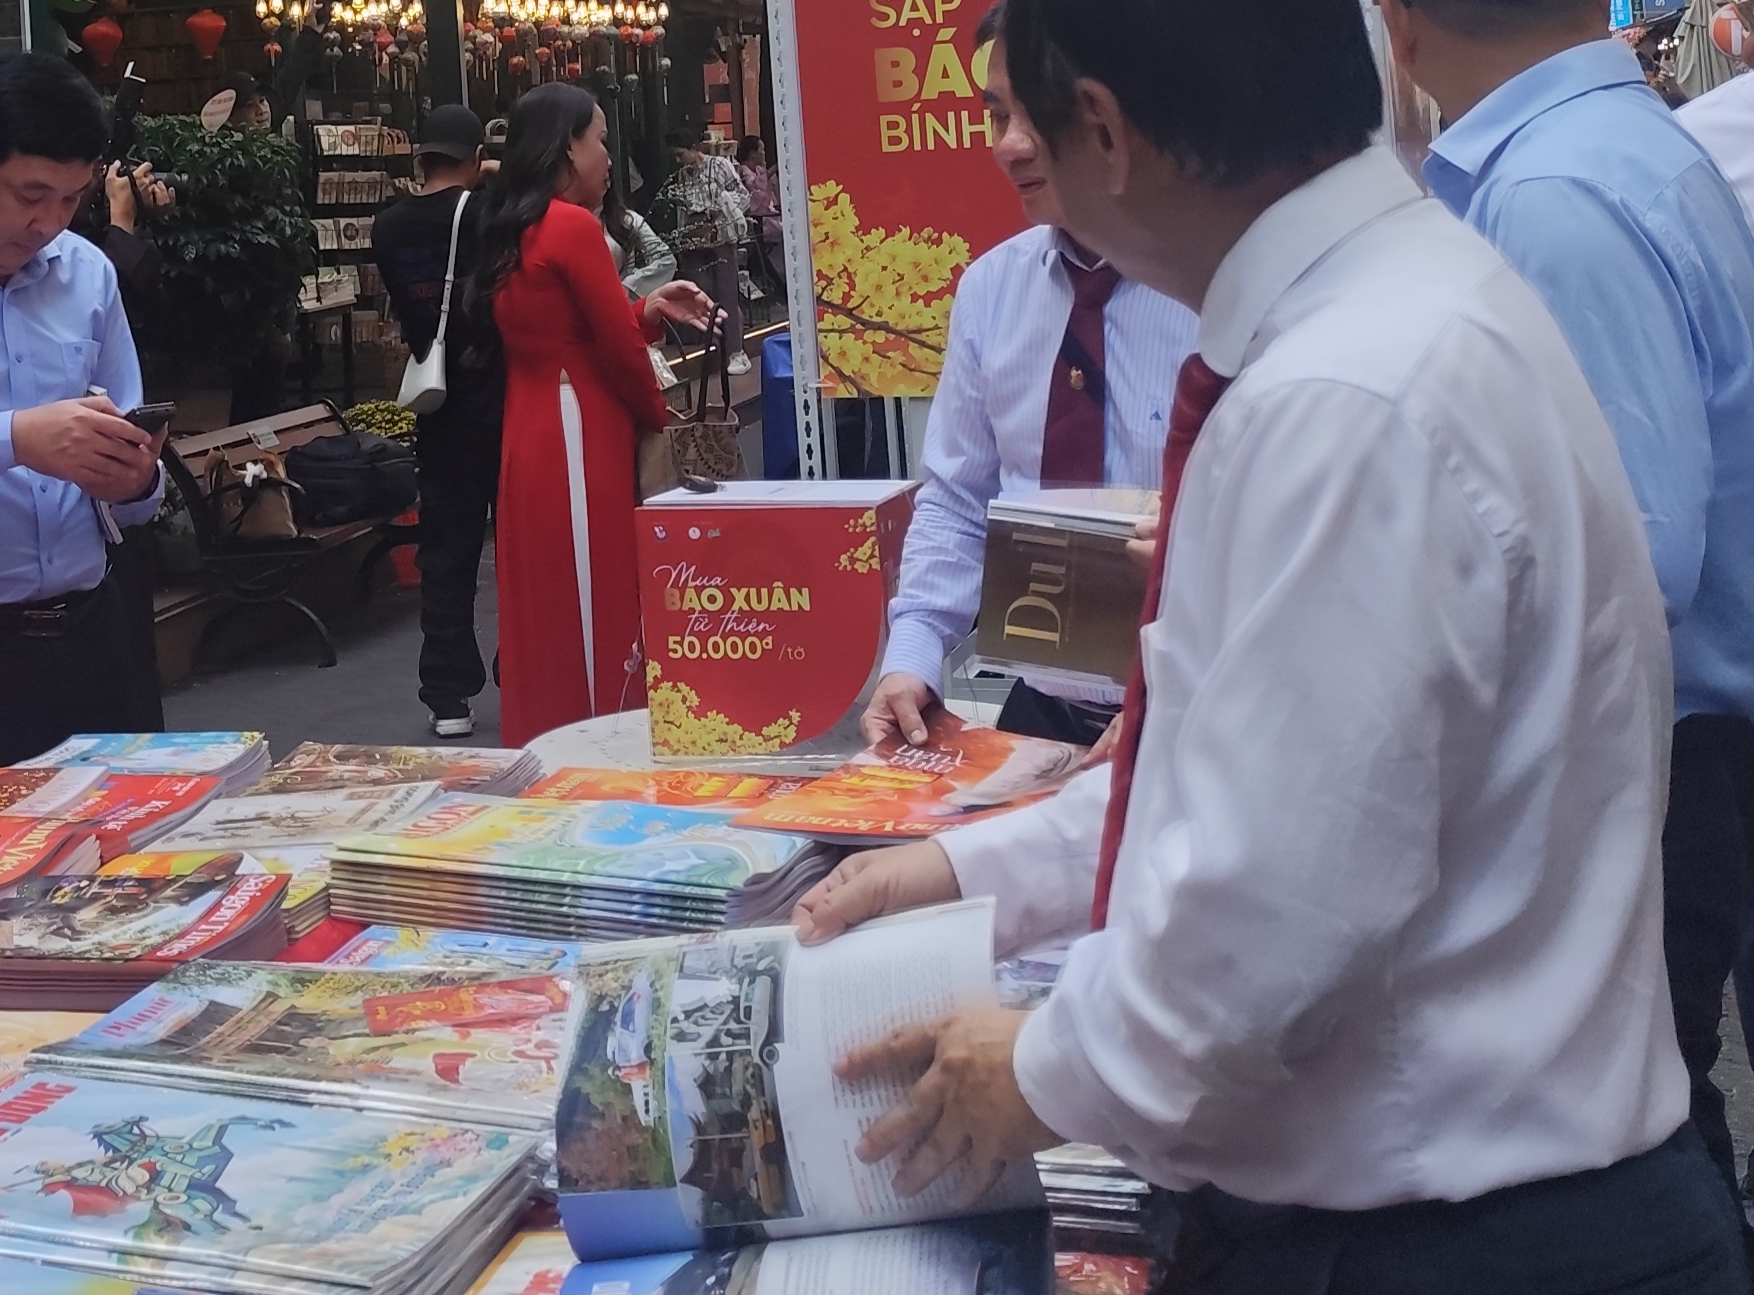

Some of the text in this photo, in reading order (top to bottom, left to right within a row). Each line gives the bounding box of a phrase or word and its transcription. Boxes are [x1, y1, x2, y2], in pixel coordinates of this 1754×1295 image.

[879, 106, 995, 153] BÍNH
[652, 561, 728, 589] Mua
[728, 581, 812, 612] XUÂN
[1002, 562, 1068, 650] Du
